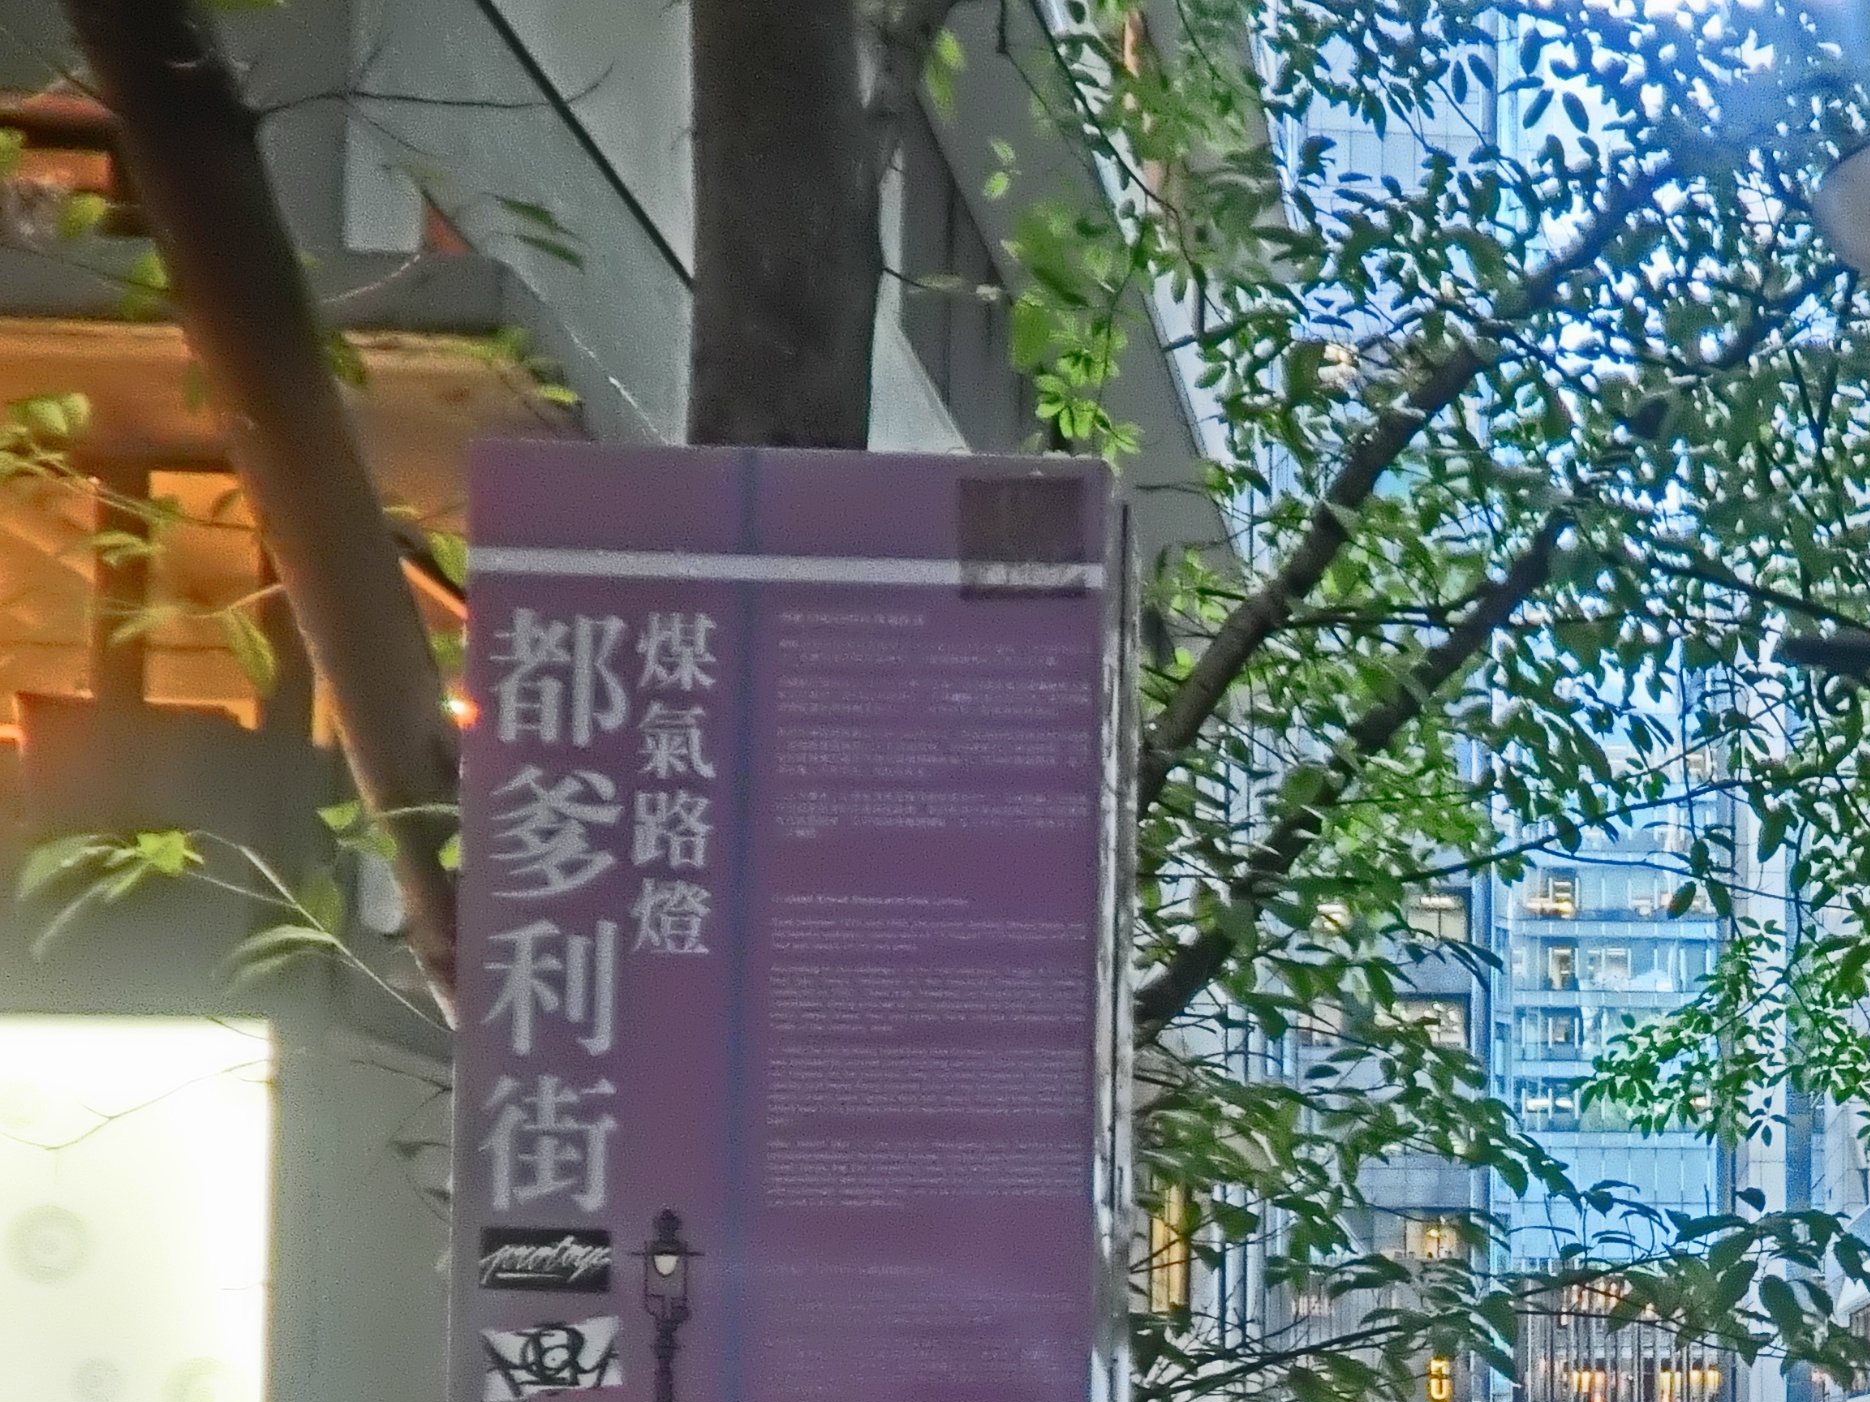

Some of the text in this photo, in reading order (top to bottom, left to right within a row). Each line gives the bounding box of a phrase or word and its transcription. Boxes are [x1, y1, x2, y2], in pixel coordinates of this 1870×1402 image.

[479, 606, 630, 1213] 都爹利街
[632, 611, 719, 955] 煤氣路燈
